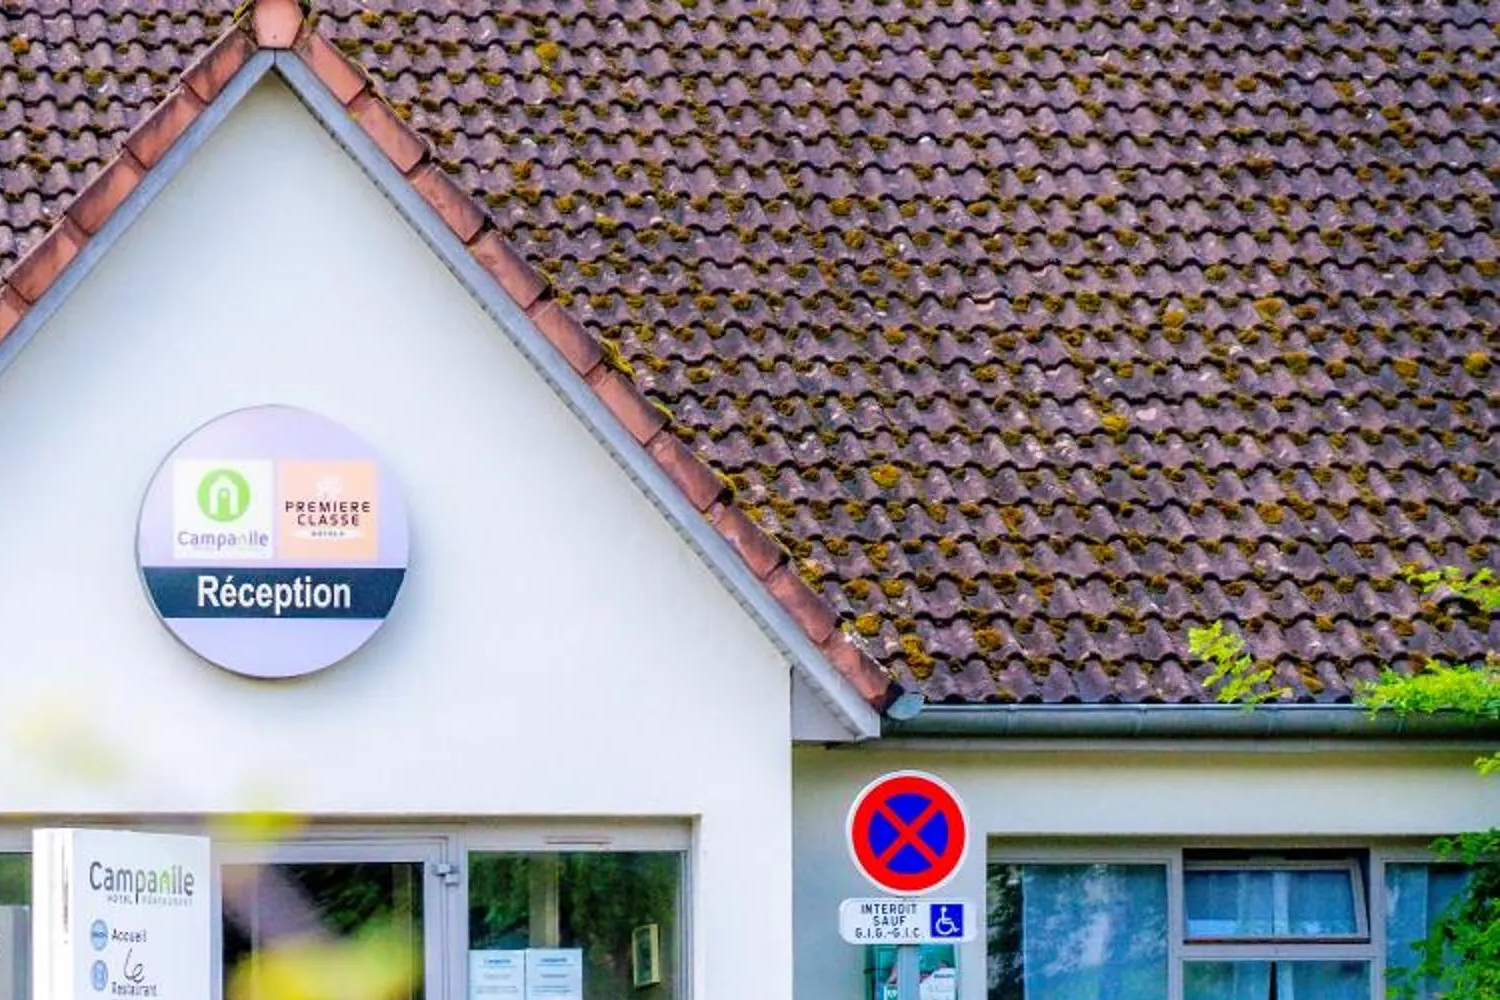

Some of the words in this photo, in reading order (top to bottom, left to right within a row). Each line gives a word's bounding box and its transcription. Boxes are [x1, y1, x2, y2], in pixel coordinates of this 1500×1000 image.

[285, 500, 371, 513] PREMIERE
[297, 513, 360, 526] CLASSE
[177, 531, 269, 551] Campanile
[198, 574, 351, 616] Réception
[89, 860, 195, 905] Campanile
[861, 903, 917, 915] INTERDIT
[873, 915, 906, 927] SAUF
[111, 928, 148, 944] Accueil
[111, 981, 158, 997] Restaurant
